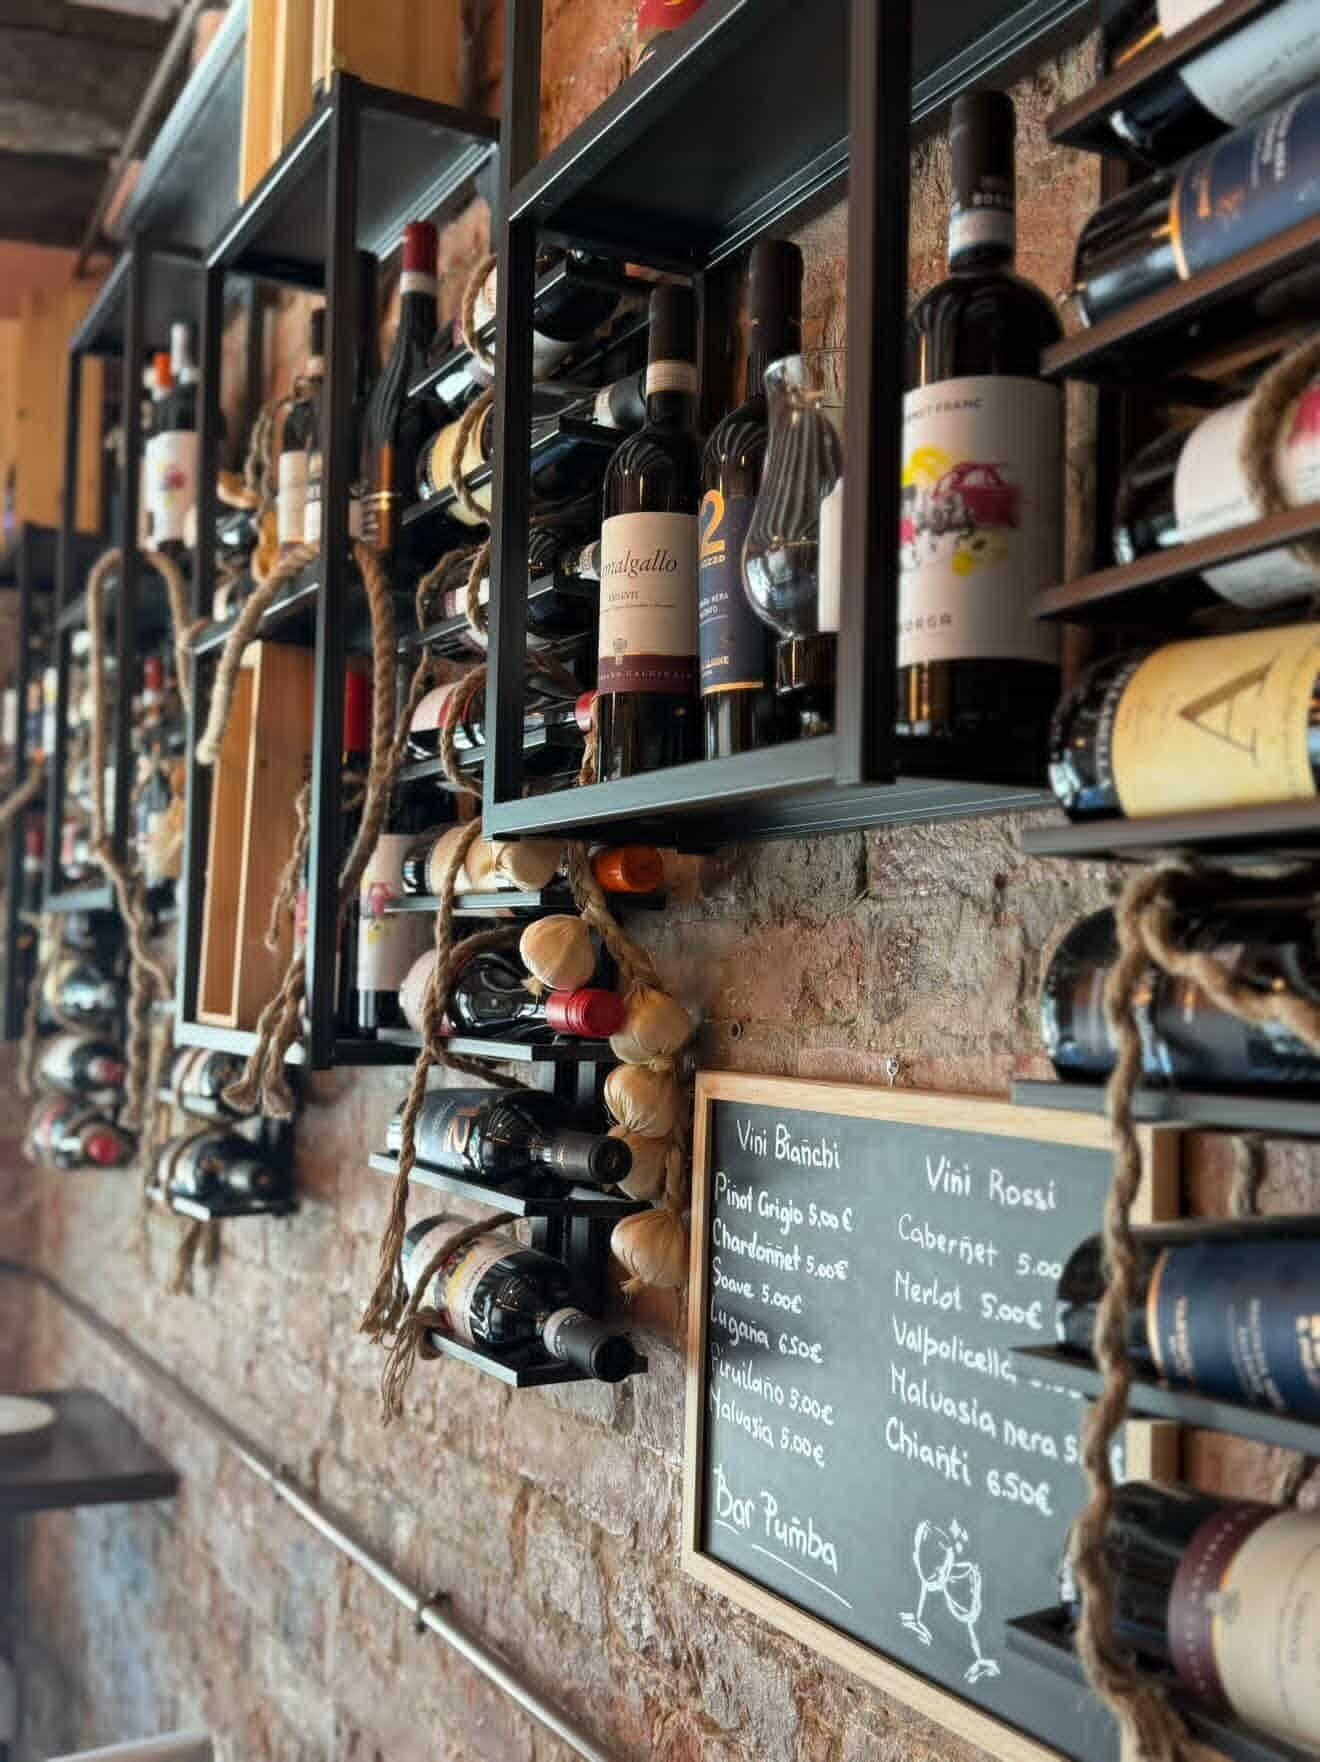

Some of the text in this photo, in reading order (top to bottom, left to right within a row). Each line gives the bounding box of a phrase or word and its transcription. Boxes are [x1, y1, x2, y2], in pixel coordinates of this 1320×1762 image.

[700, 489, 725, 554] 2
[737, 1119, 840, 1168] Vini Bianchi
[714, 1171, 753, 1212] Pinot
[758, 1191, 804, 1235] Grigio
[926, 1154, 1056, 1211] Vini Rossi
[898, 1213, 999, 1268] Cabernet
[712, 1256, 755, 1299] Soave
[895, 1269, 963, 1311] Merlot
[710, 1295, 770, 1349] Lugana
[891, 1361, 998, 1438] Malvasia
[885, 1416, 972, 1487] Chianti
[713, 1463, 838, 1576] Bar Pumba
